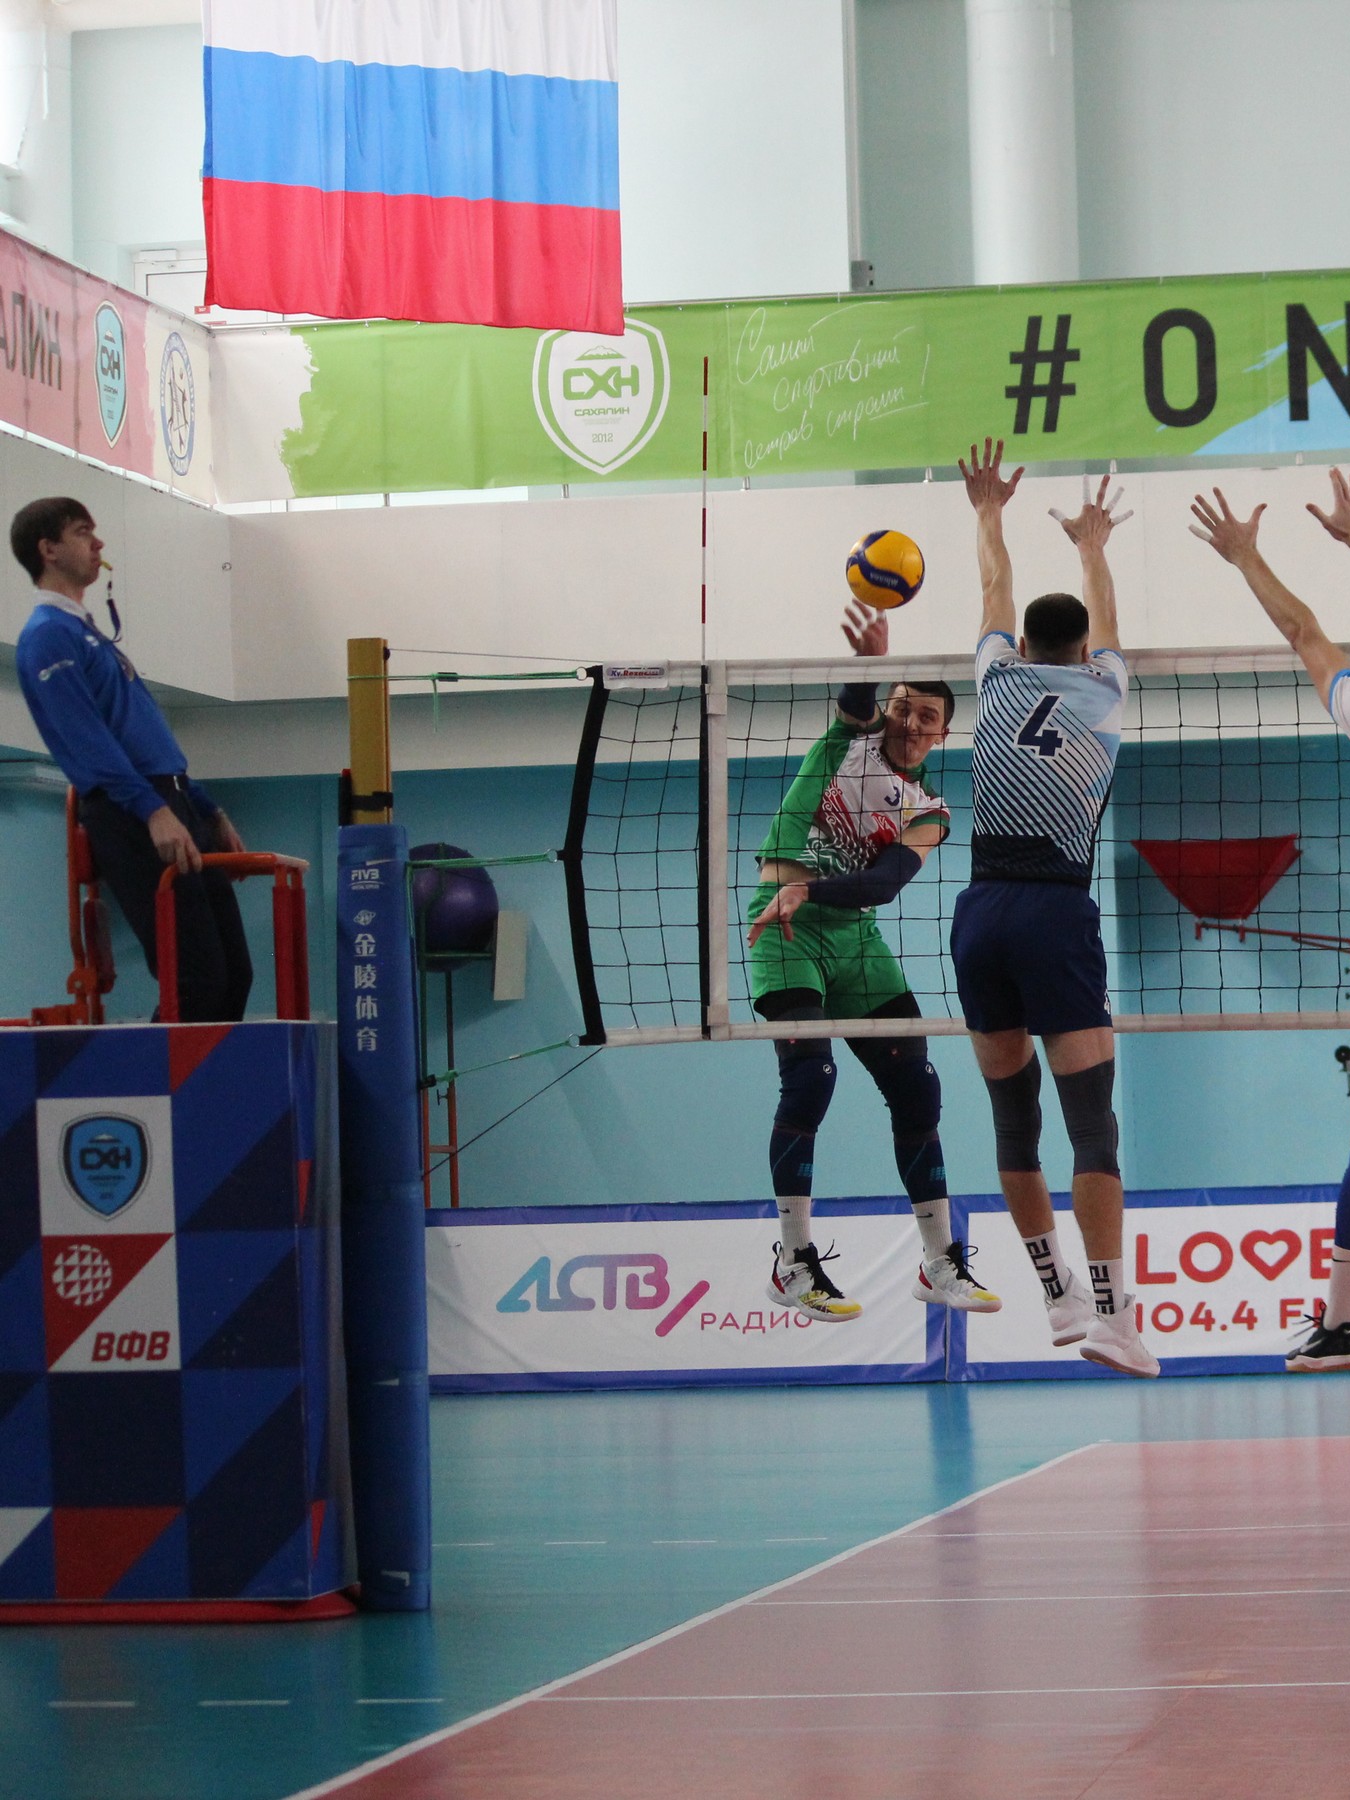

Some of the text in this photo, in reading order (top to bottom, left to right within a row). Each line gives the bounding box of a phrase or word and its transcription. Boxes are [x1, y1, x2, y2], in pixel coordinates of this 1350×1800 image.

[574, 406, 630, 417] САХАЛИН
[592, 433, 614, 443] 2012
[1017, 695, 1063, 757] 4
[884, 785, 901, 807] 3
[351, 868, 380, 881] FIVB
[354, 933, 378, 1051] 金陵体育
[496, 1253, 670, 1313] АСТВ
[700, 1310, 812, 1335] РАДИО
[92, 1330, 171, 1362] ВФВ
